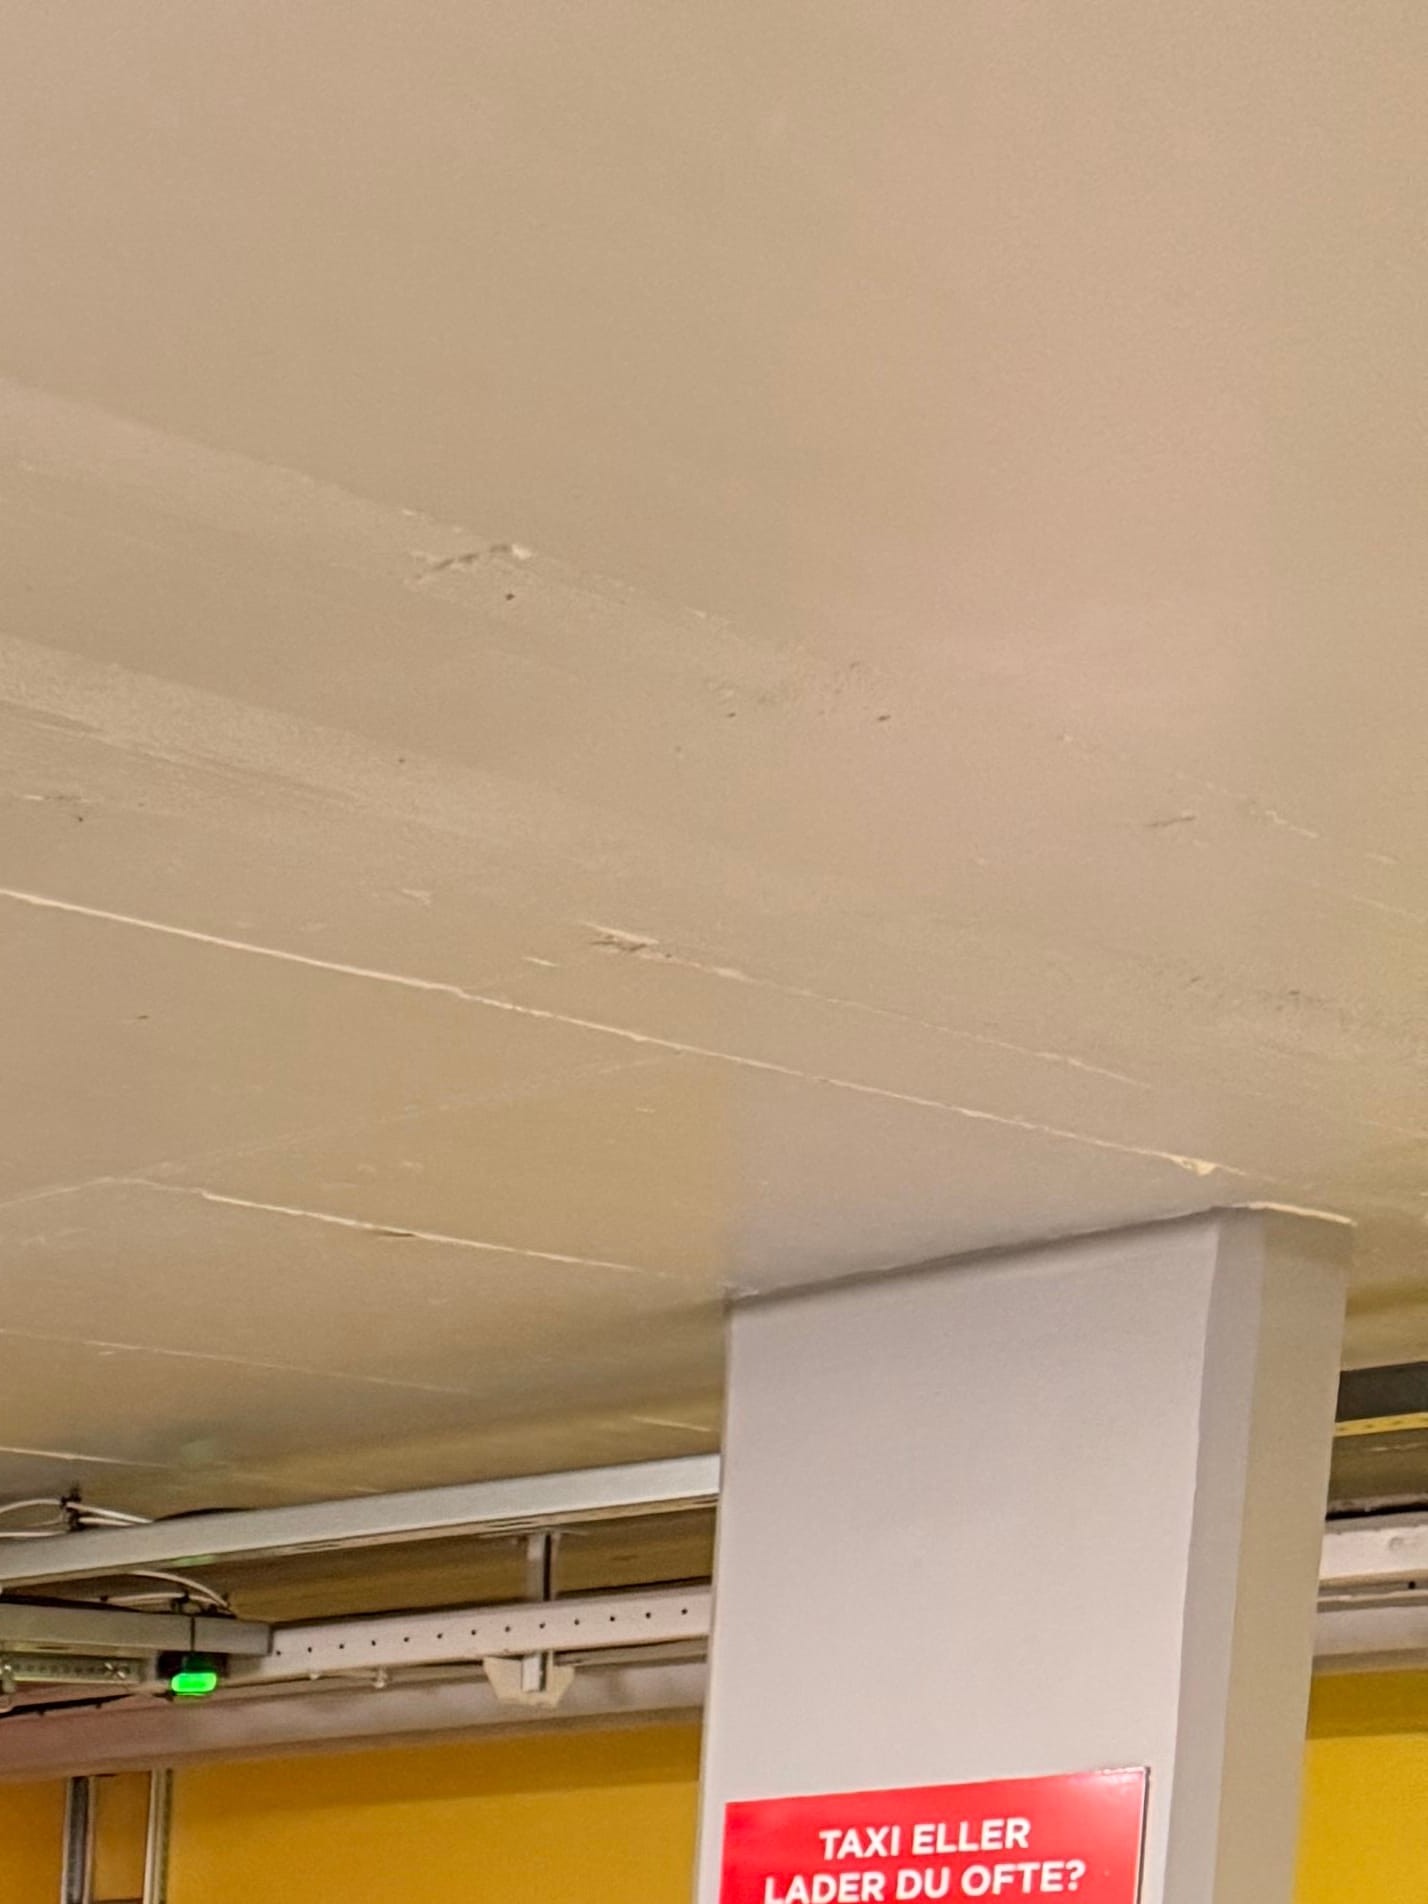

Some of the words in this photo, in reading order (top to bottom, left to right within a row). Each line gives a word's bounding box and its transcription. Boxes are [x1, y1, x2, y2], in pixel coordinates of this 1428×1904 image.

[819, 1826, 900, 1860] TAXI
[912, 1817, 1031, 1855] ELLER
[896, 1866, 950, 1901] DU
[960, 1859, 1086, 1897] OFTE?
